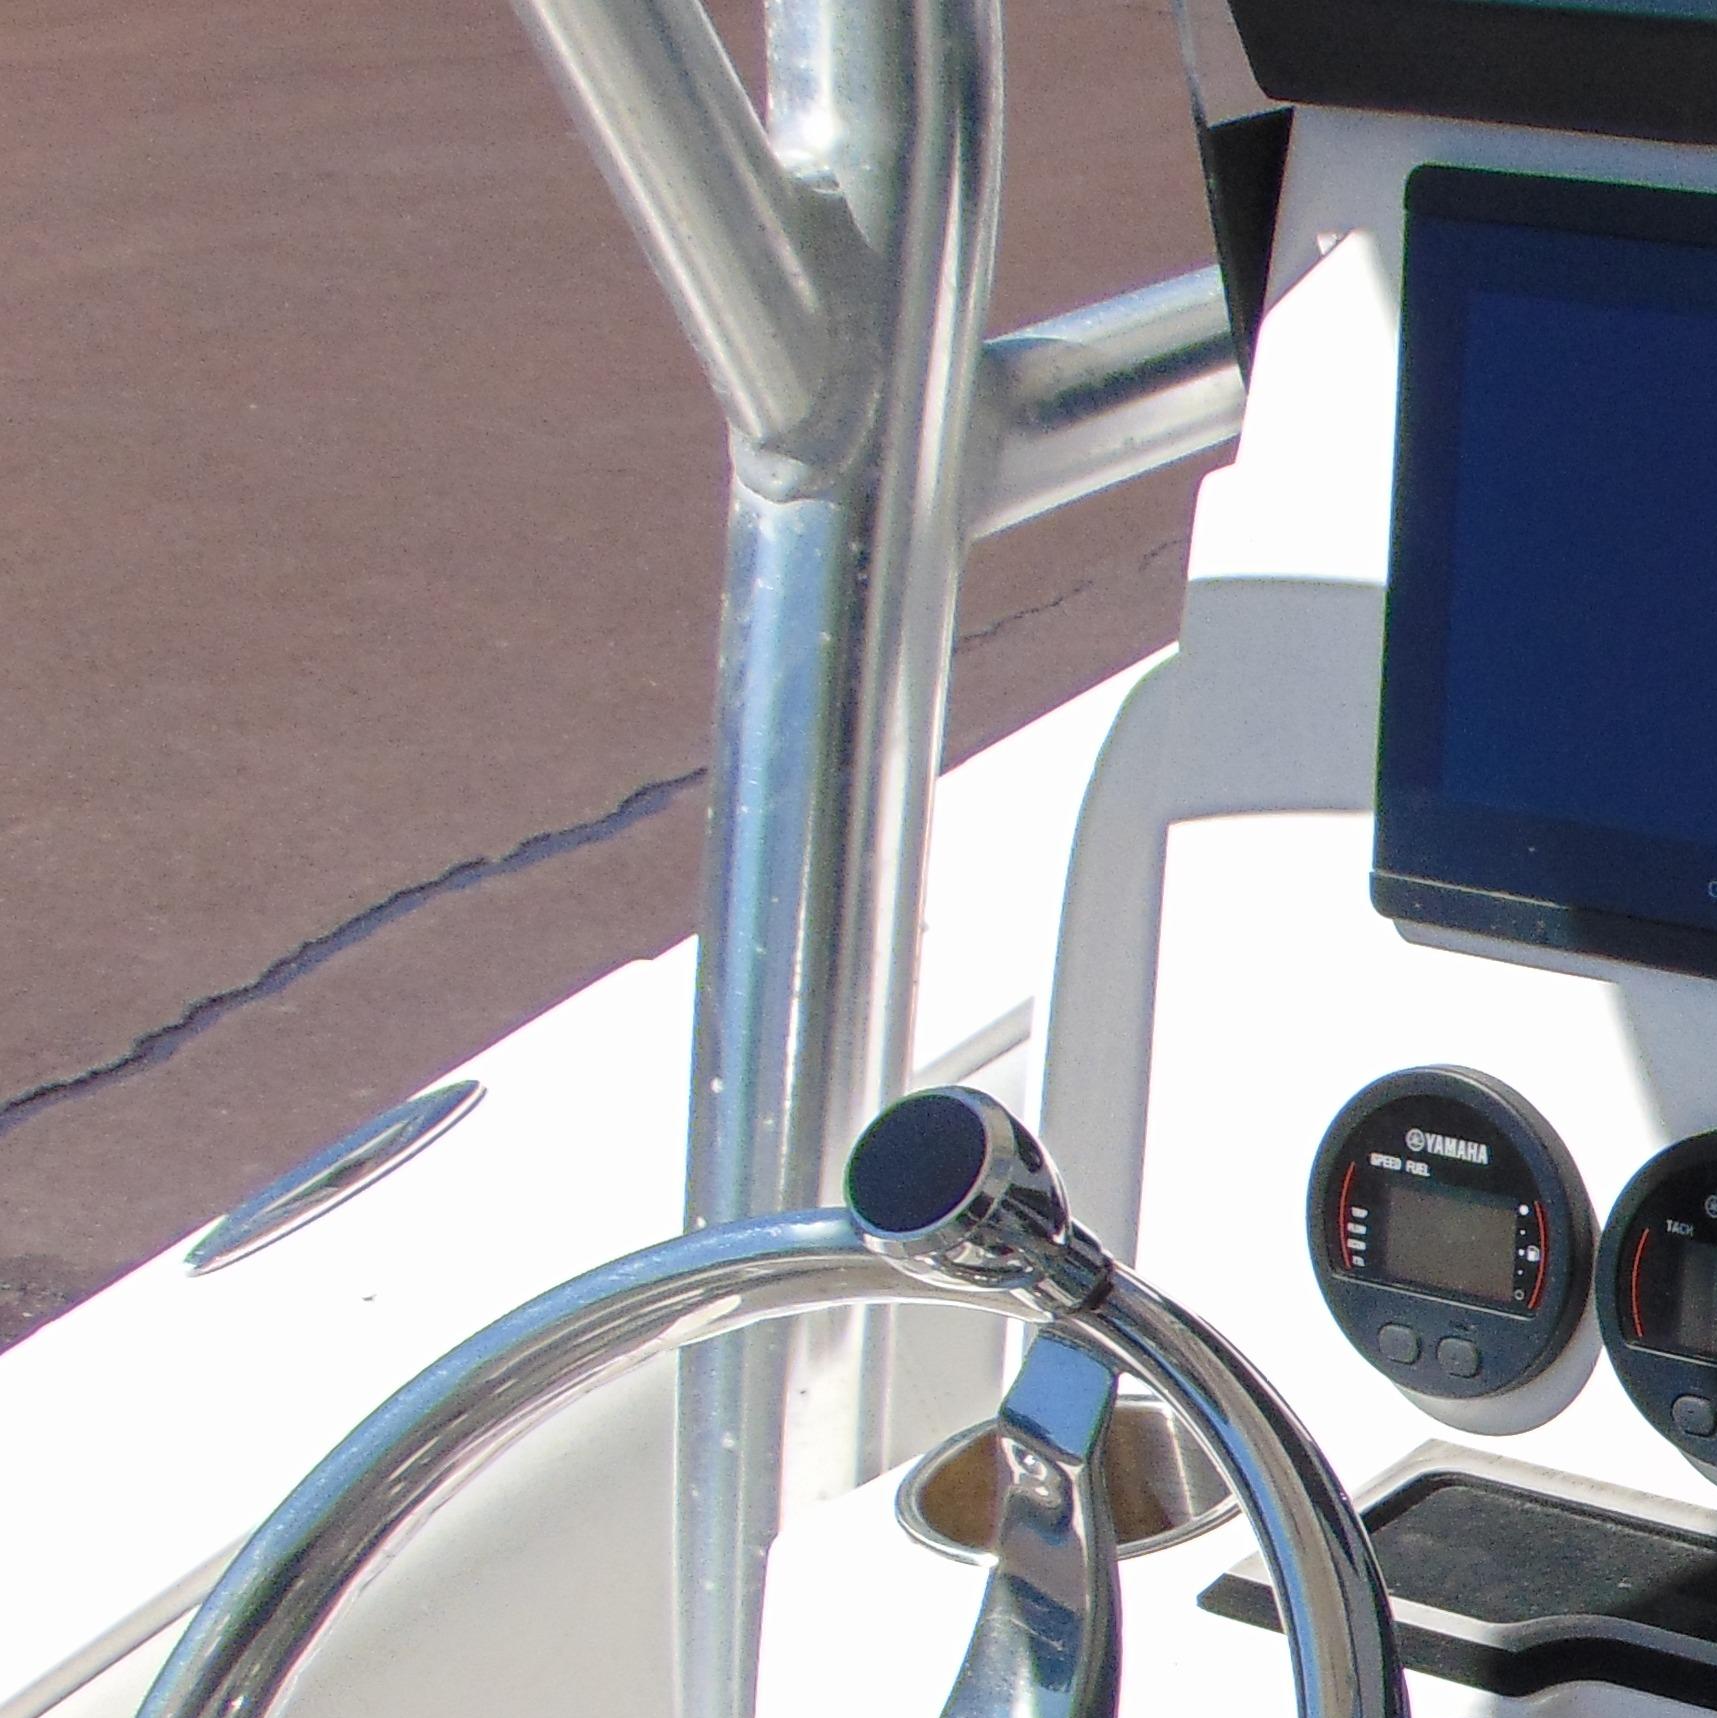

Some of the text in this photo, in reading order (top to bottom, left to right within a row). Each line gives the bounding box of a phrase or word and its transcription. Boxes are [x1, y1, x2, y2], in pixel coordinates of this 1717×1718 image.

[1425, 1132, 1489, 1165] YAMAHA
[1370, 1152, 1431, 1177] SPEED FUEL
[1666, 1219, 1694, 1237] TACH
